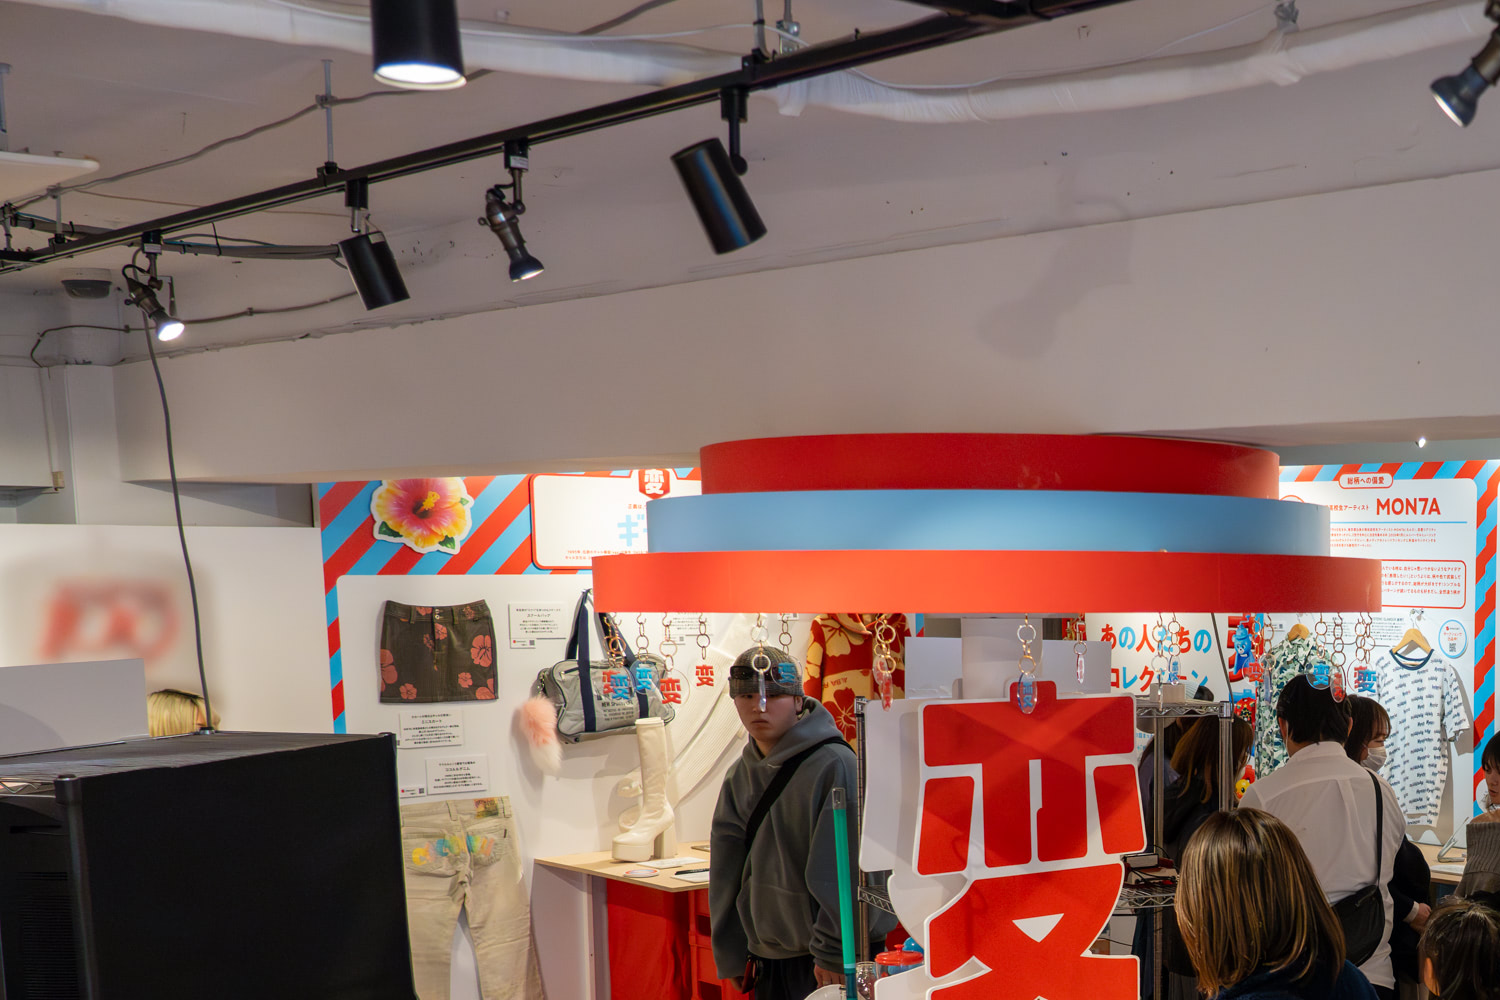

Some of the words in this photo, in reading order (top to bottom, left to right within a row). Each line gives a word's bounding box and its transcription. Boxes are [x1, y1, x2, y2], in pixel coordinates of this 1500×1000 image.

[644, 470, 665, 494] 変
[1347, 476, 1384, 485] 総柄への偏愛
[1376, 498, 1441, 515] MON7A
[617, 514, 647, 546] ギ
[1101, 624, 1211, 654] あの人たちの
[695, 664, 714, 687] 変
[1111, 665, 1208, 692] コレクン
[660, 678, 681, 704] 変
